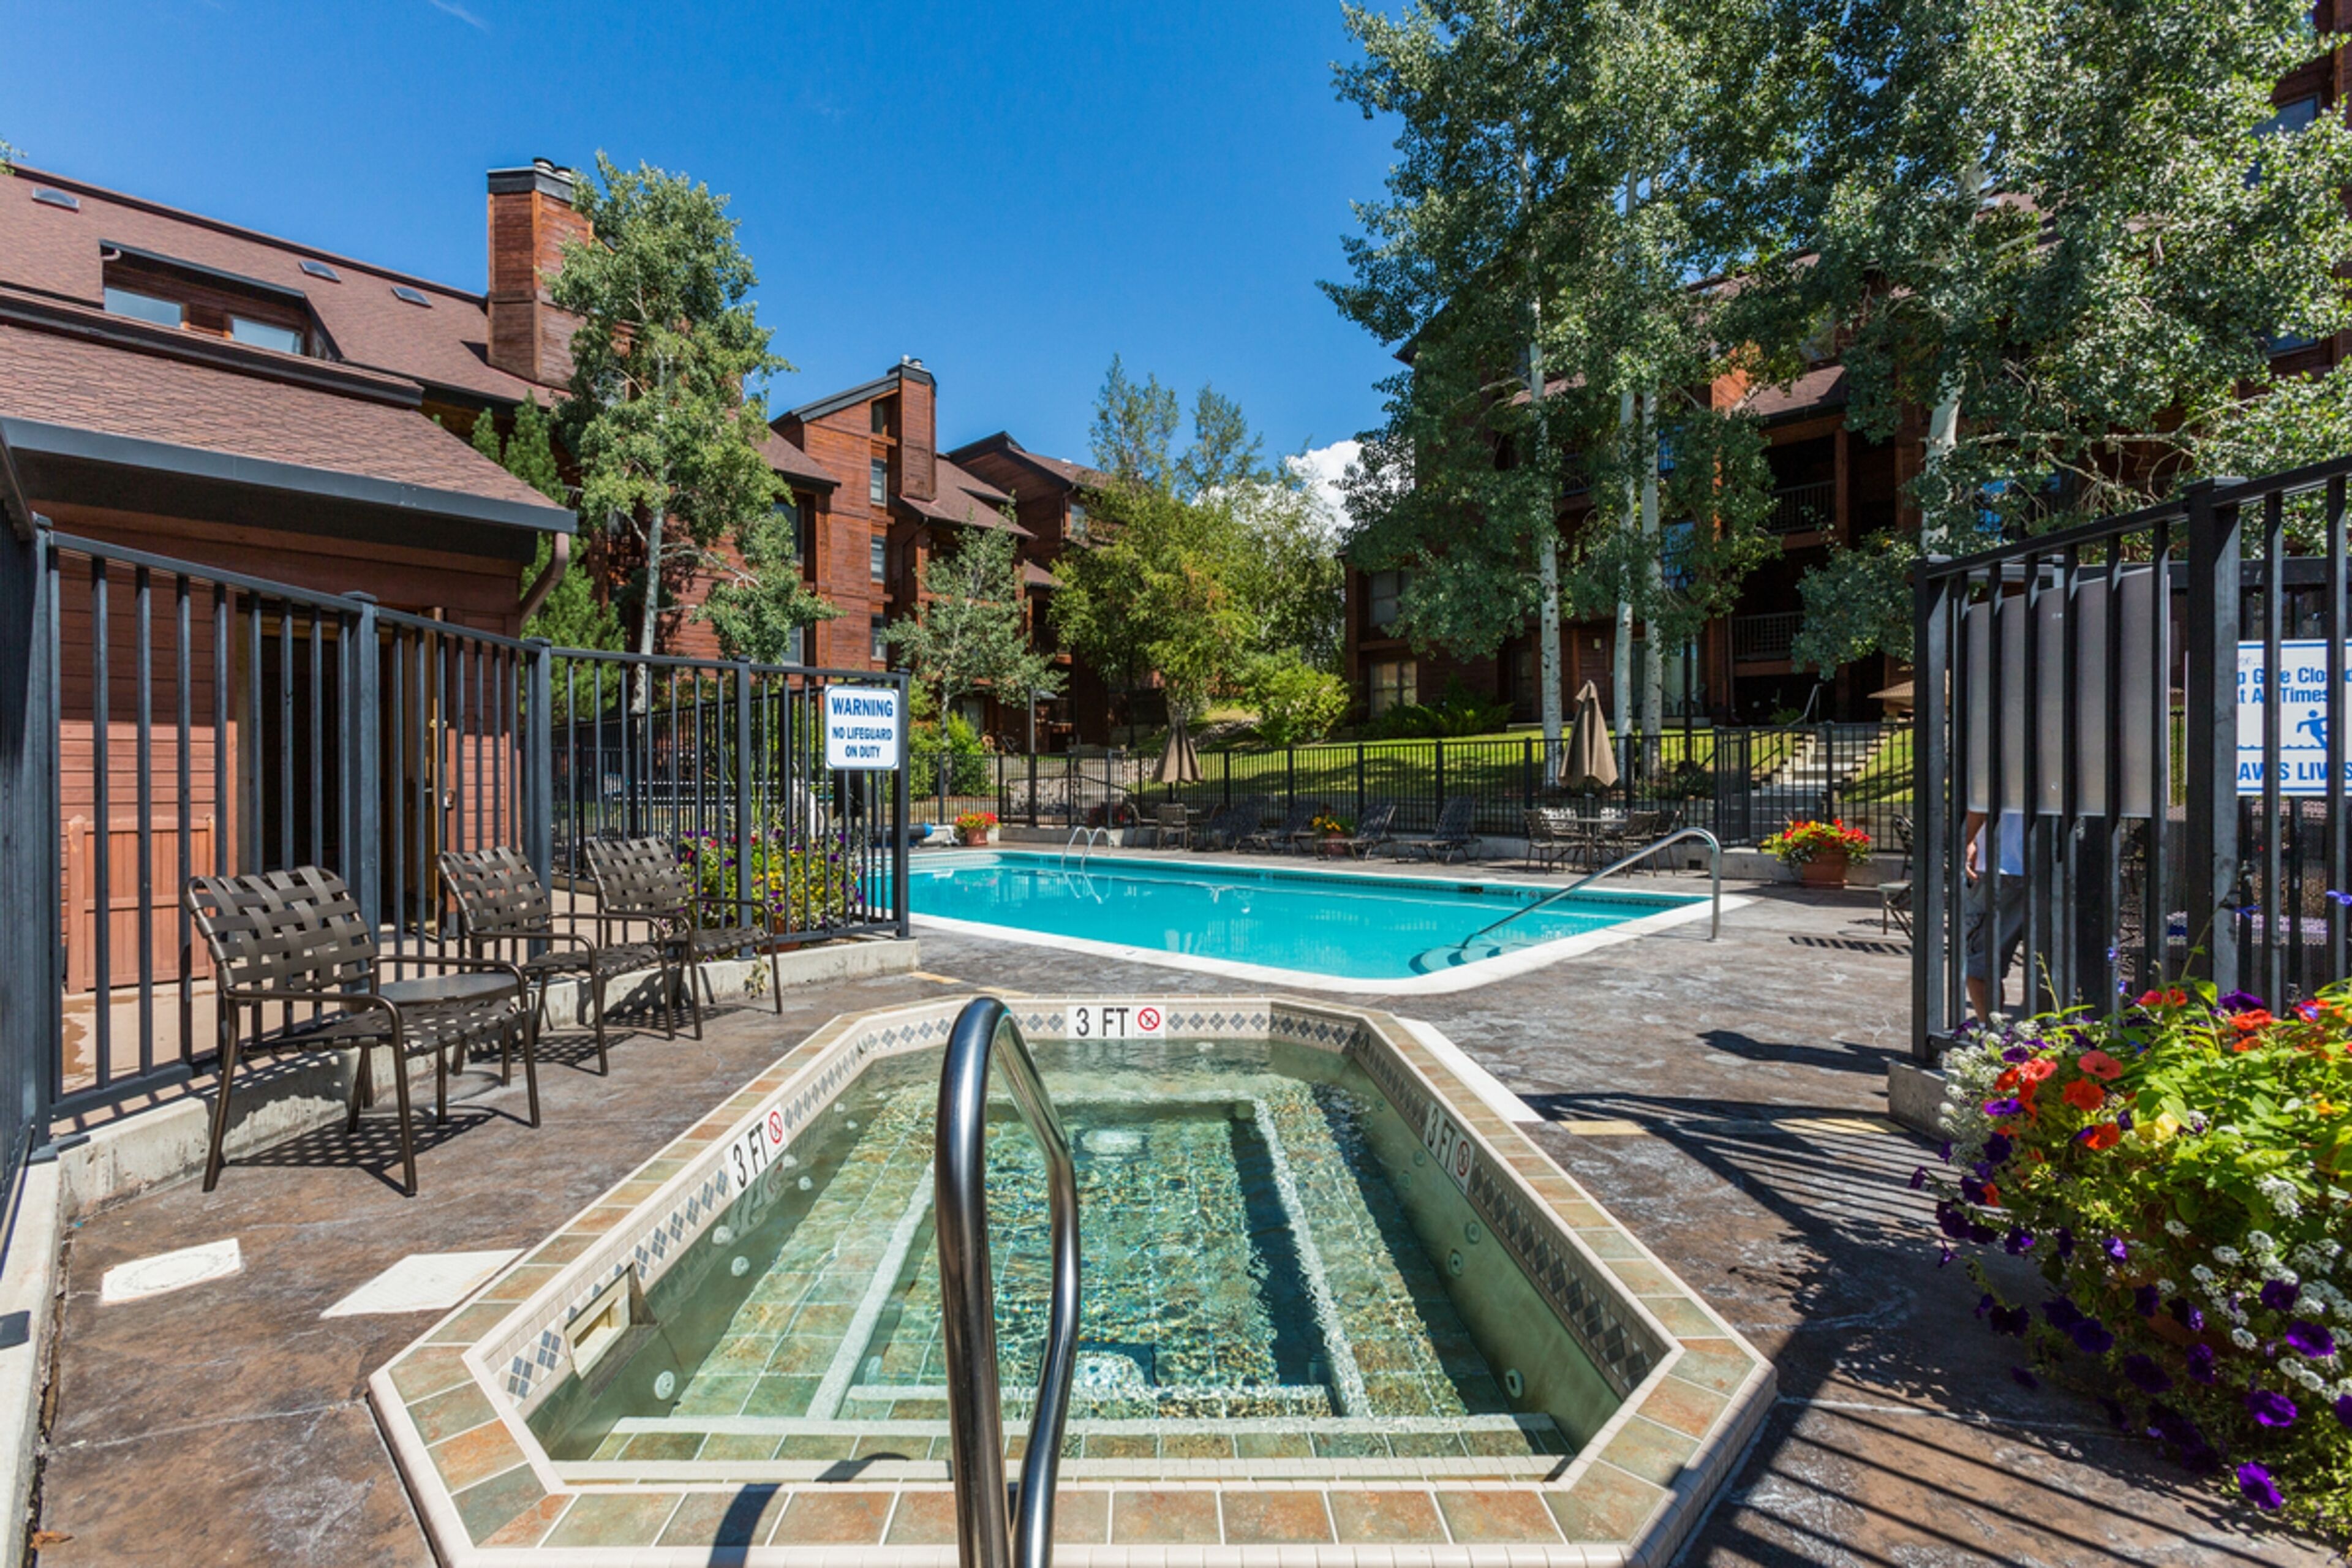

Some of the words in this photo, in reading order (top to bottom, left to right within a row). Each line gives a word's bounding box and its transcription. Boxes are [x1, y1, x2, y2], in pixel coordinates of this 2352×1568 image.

[2253, 668, 2290, 684] Ge
[2297, 666, 2352, 684] Clod
[831, 697, 893, 717] WARNING
[832, 726, 845, 739] NO
[847, 727, 893, 741] LIFEGUARD
[845, 745, 857, 758] ON
[859, 746, 881, 758] DUTY
[2237, 762, 2290, 781] AVS
[2297, 762, 2352, 781] LIVS
[1076, 1007, 1090, 1037] 3
[1102, 1007, 1129, 1037] FT
[1428, 1107, 1439, 1148] 3
[1438, 1119, 1457, 1169] FT
[733, 1143, 747, 1189] 3
[747, 1121, 768, 1175] FT
